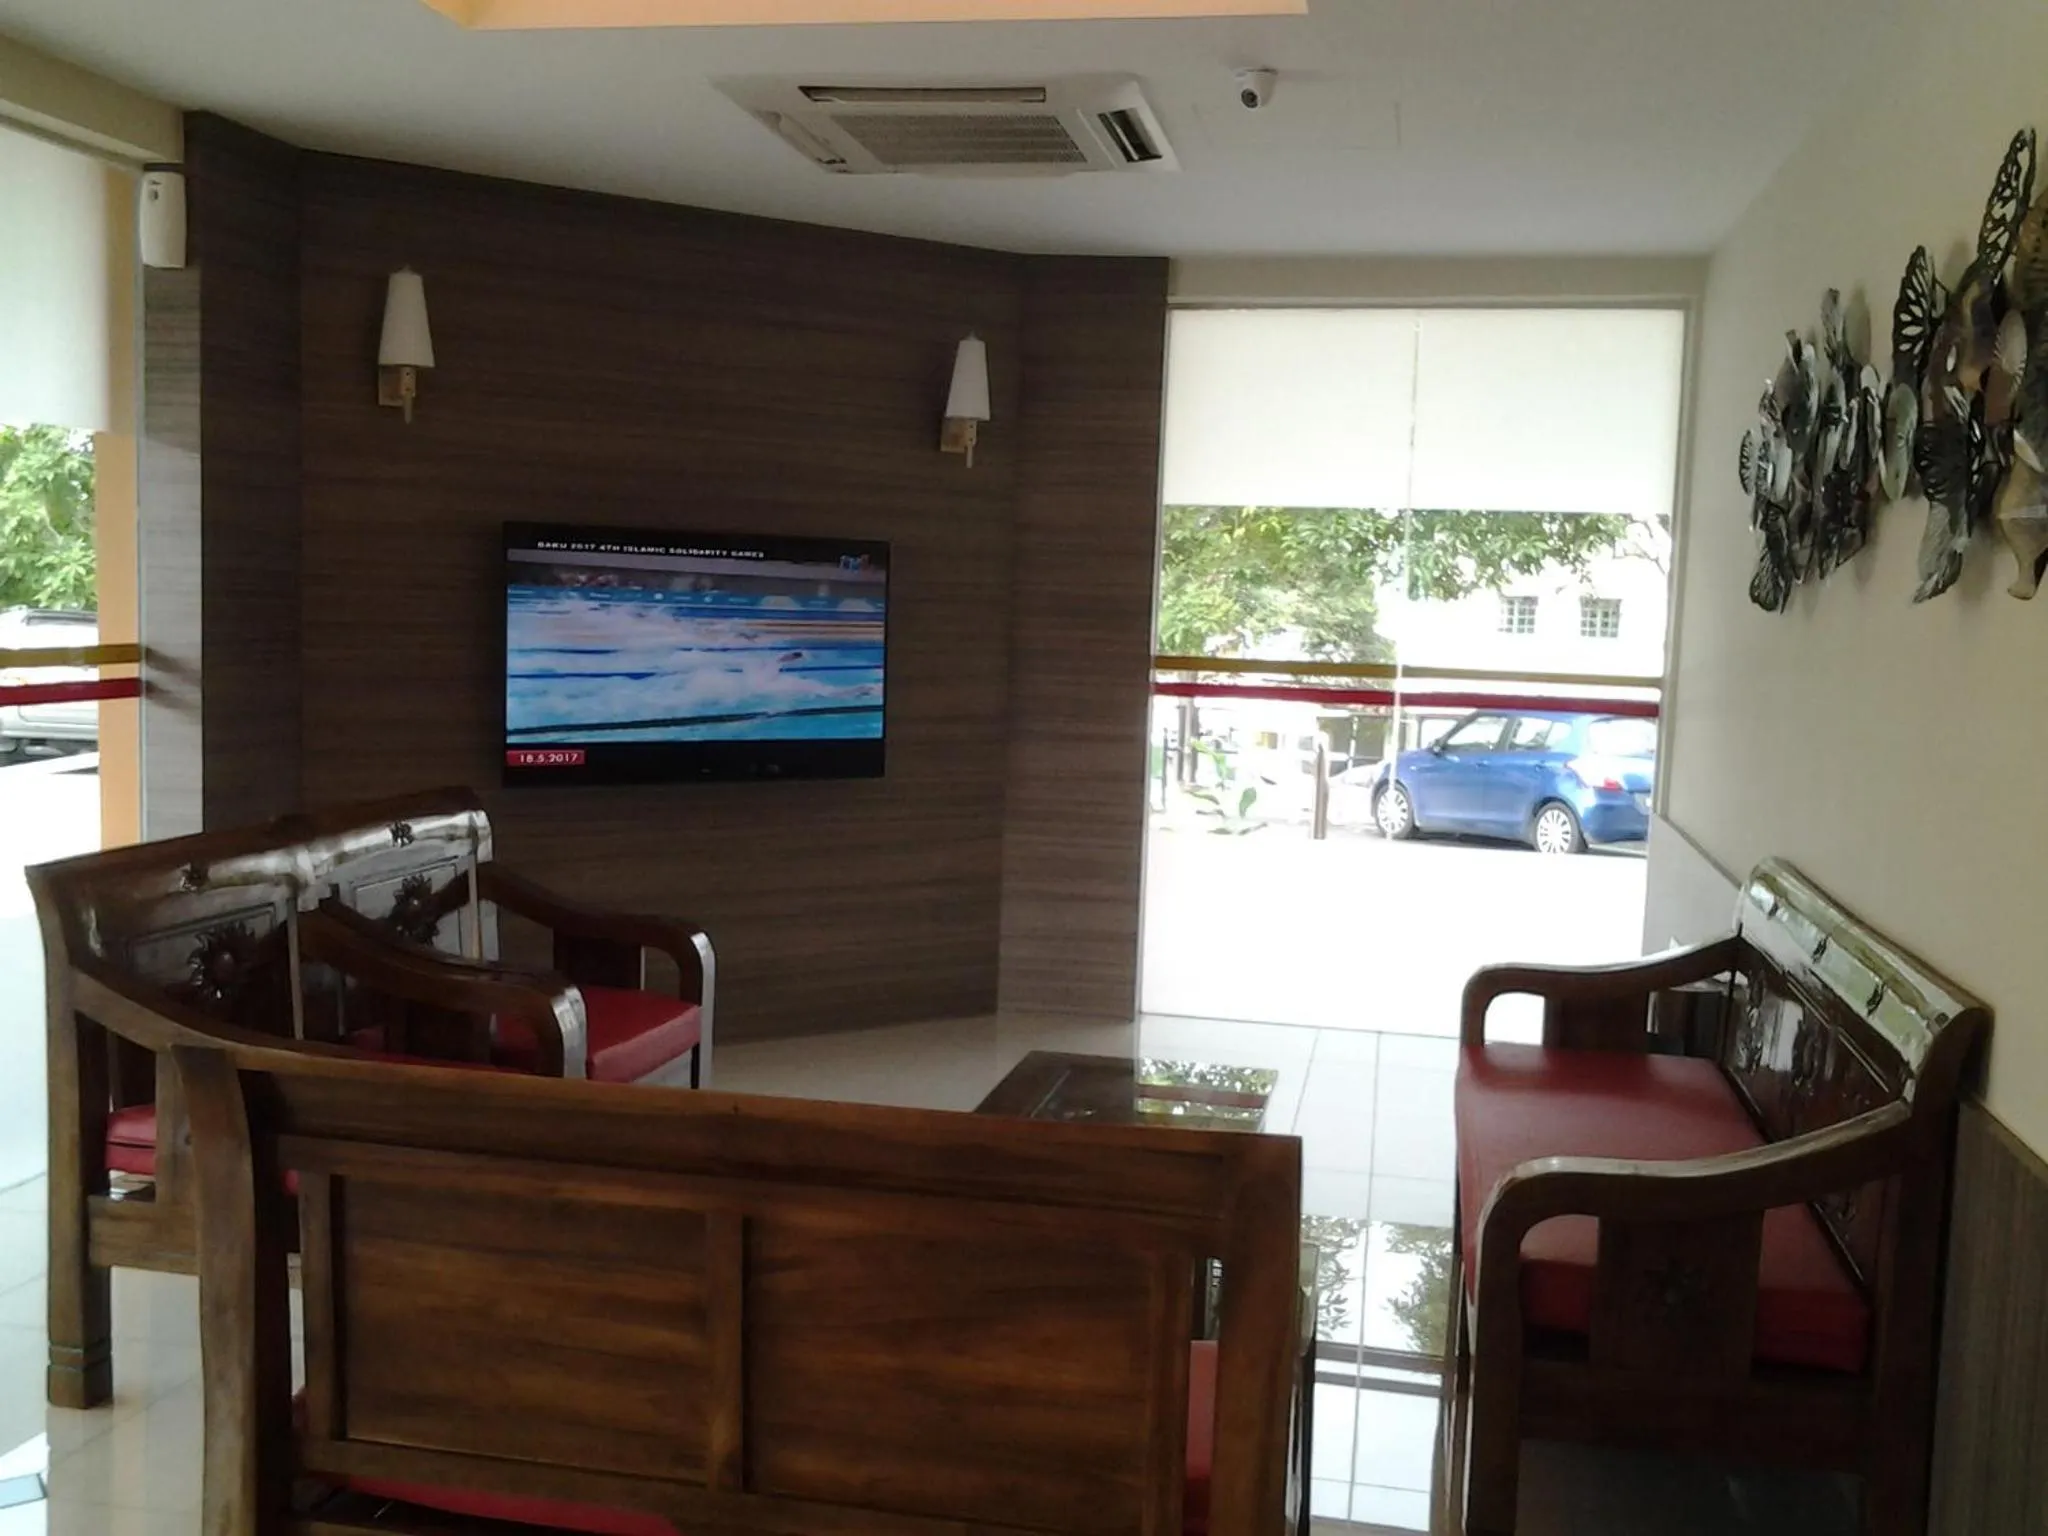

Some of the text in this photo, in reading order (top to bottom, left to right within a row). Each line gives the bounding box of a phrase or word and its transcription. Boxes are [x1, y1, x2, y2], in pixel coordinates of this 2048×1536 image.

[537, 541, 567, 549] BAKU
[623, 545, 666, 554] ISLAMIC
[668, 547, 727, 556] SOLIDARITY
[731, 550, 765, 558] GAMES
[520, 753, 578, 763] 18.5.2017
